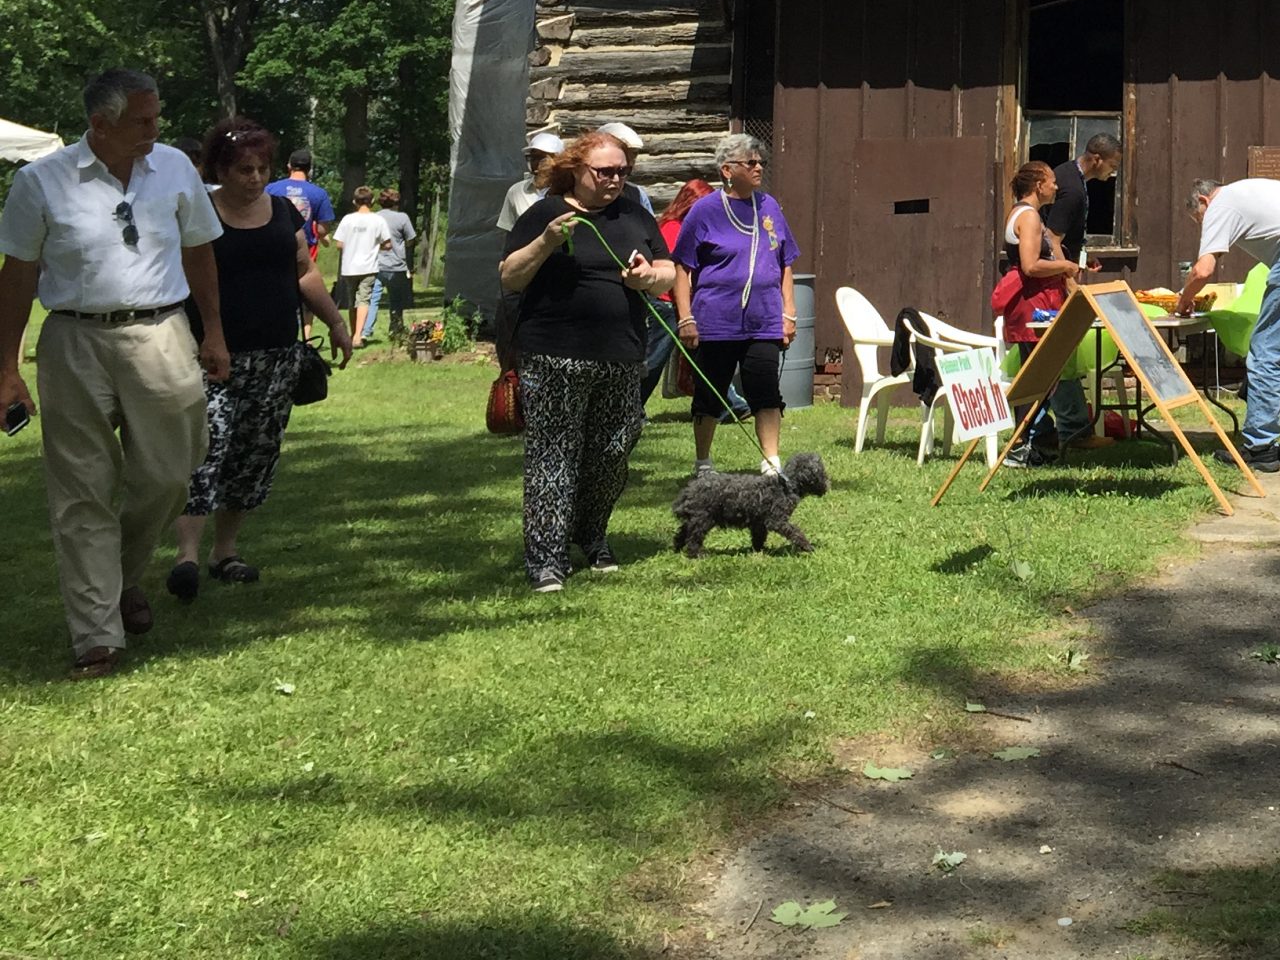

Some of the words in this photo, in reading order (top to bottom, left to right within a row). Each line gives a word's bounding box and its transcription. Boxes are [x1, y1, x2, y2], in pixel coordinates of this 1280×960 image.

[958, 354, 973, 371] Park
[951, 378, 996, 431] Check
[988, 376, 1009, 421] In
